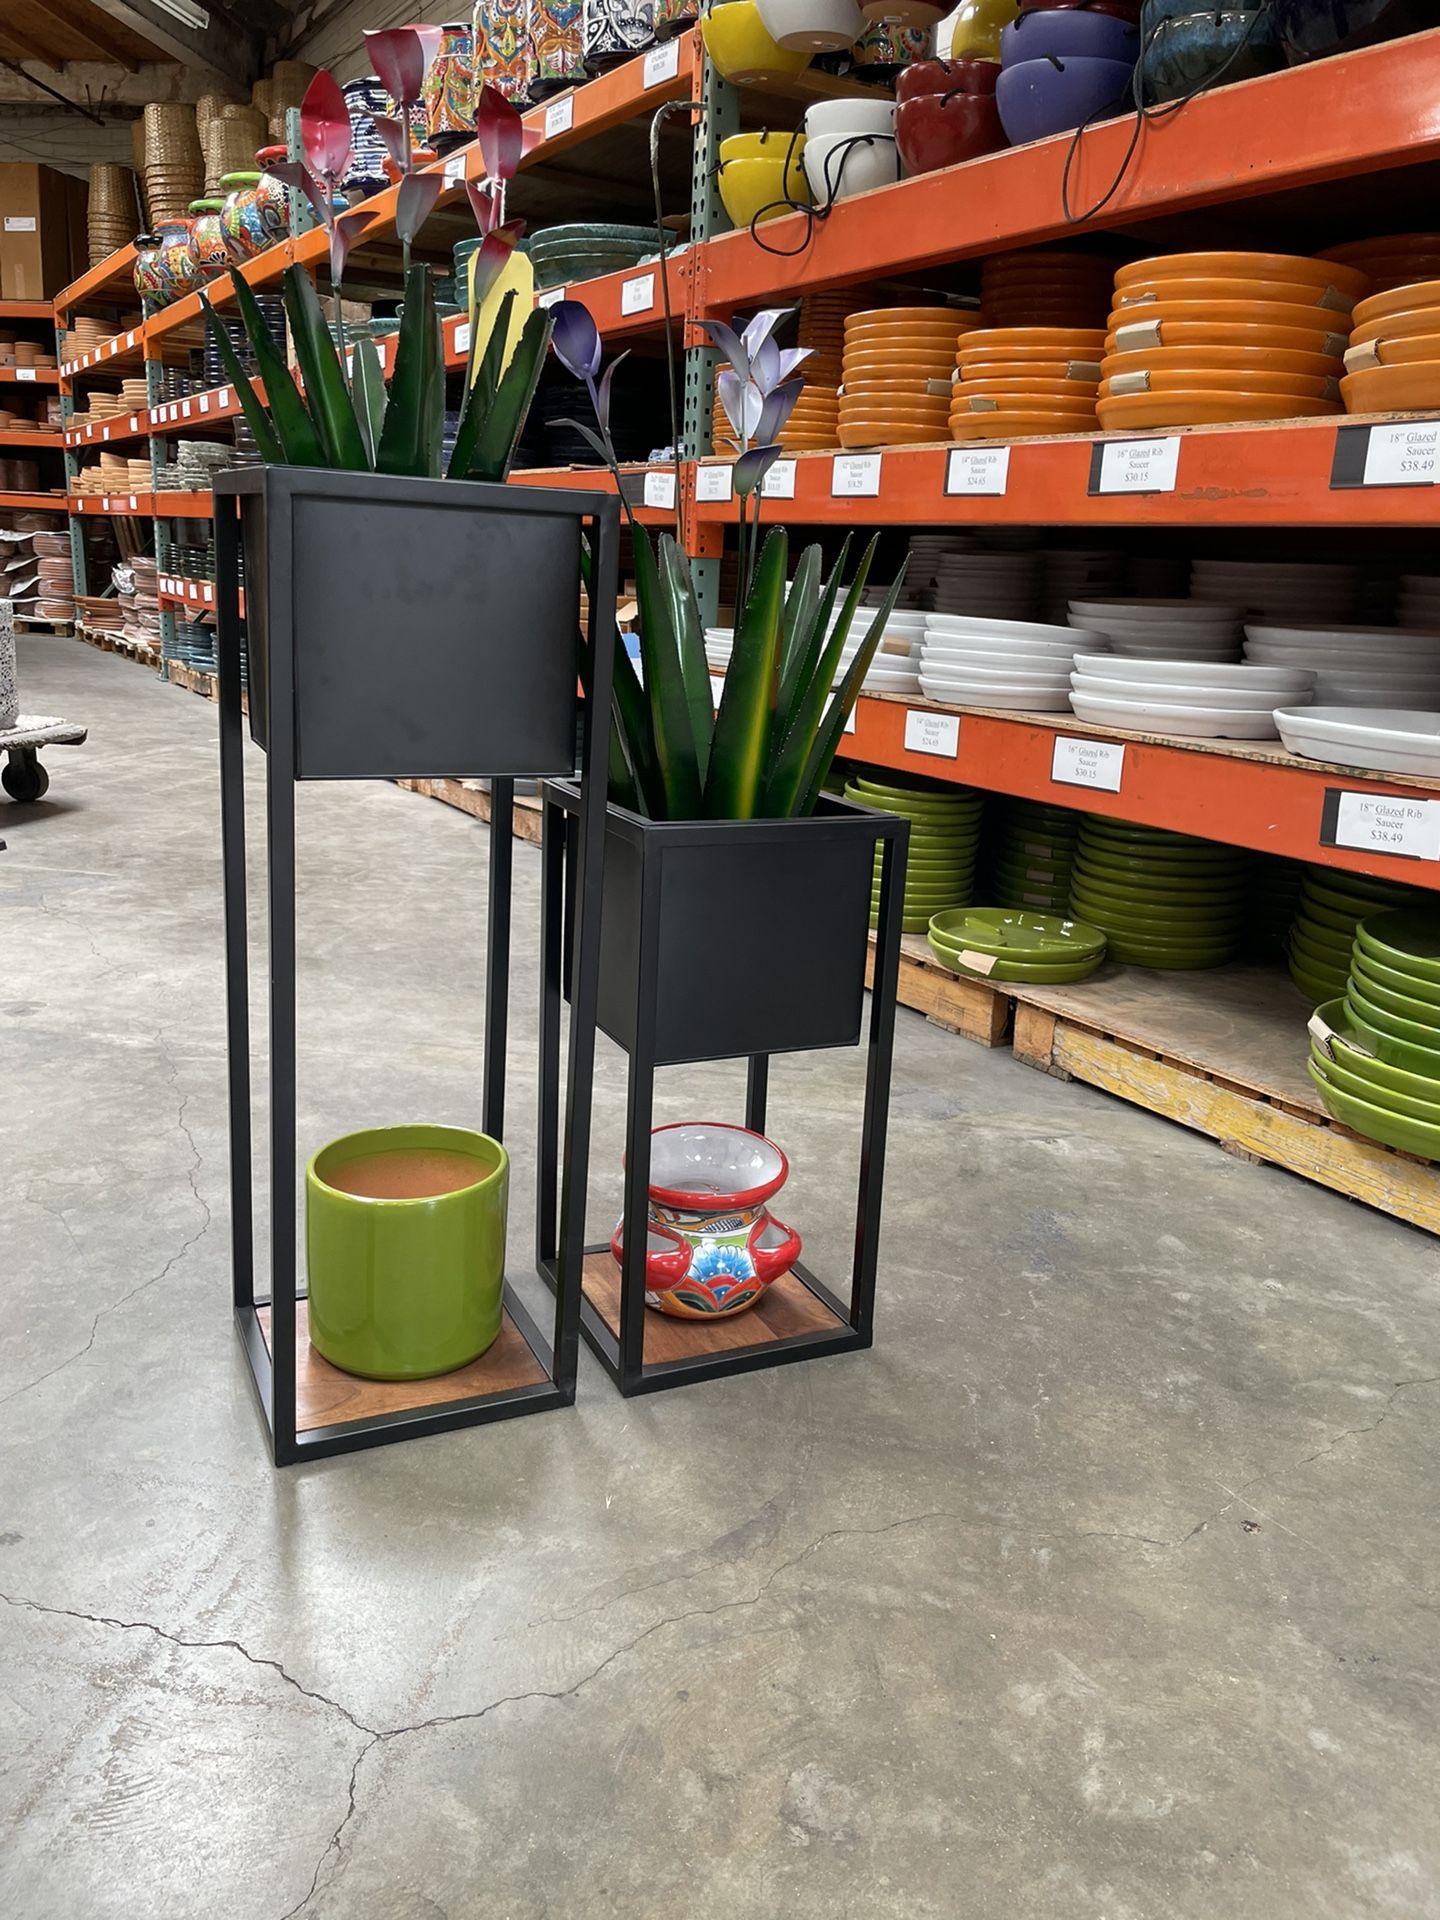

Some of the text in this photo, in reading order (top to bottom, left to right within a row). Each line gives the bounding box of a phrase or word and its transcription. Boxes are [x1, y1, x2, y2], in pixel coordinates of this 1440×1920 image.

[1406, 431, 1437, 444] Glazed
[1129, 448, 1150, 459] Glazed
[1151, 447, 1163, 457] Rib
[1406, 446, 1436, 456] Saucer
[1129, 460, 1150, 469] Saucer
[1400, 460, 1434, 472] $38.49
[1124, 472, 1149, 482] $30.15
[1079, 746, 1098, 758] Glazed
[1099, 750, 1110, 759] Rib
[1078, 758, 1097, 767] Saucer
[1074, 768, 1097, 779] $30.15
[1375, 804, 1405, 818] Glazed
[1406, 808, 1423, 819] Rib
[1375, 818, 1404, 829] Saucer
[1370, 830, 1403, 843] $38.49
